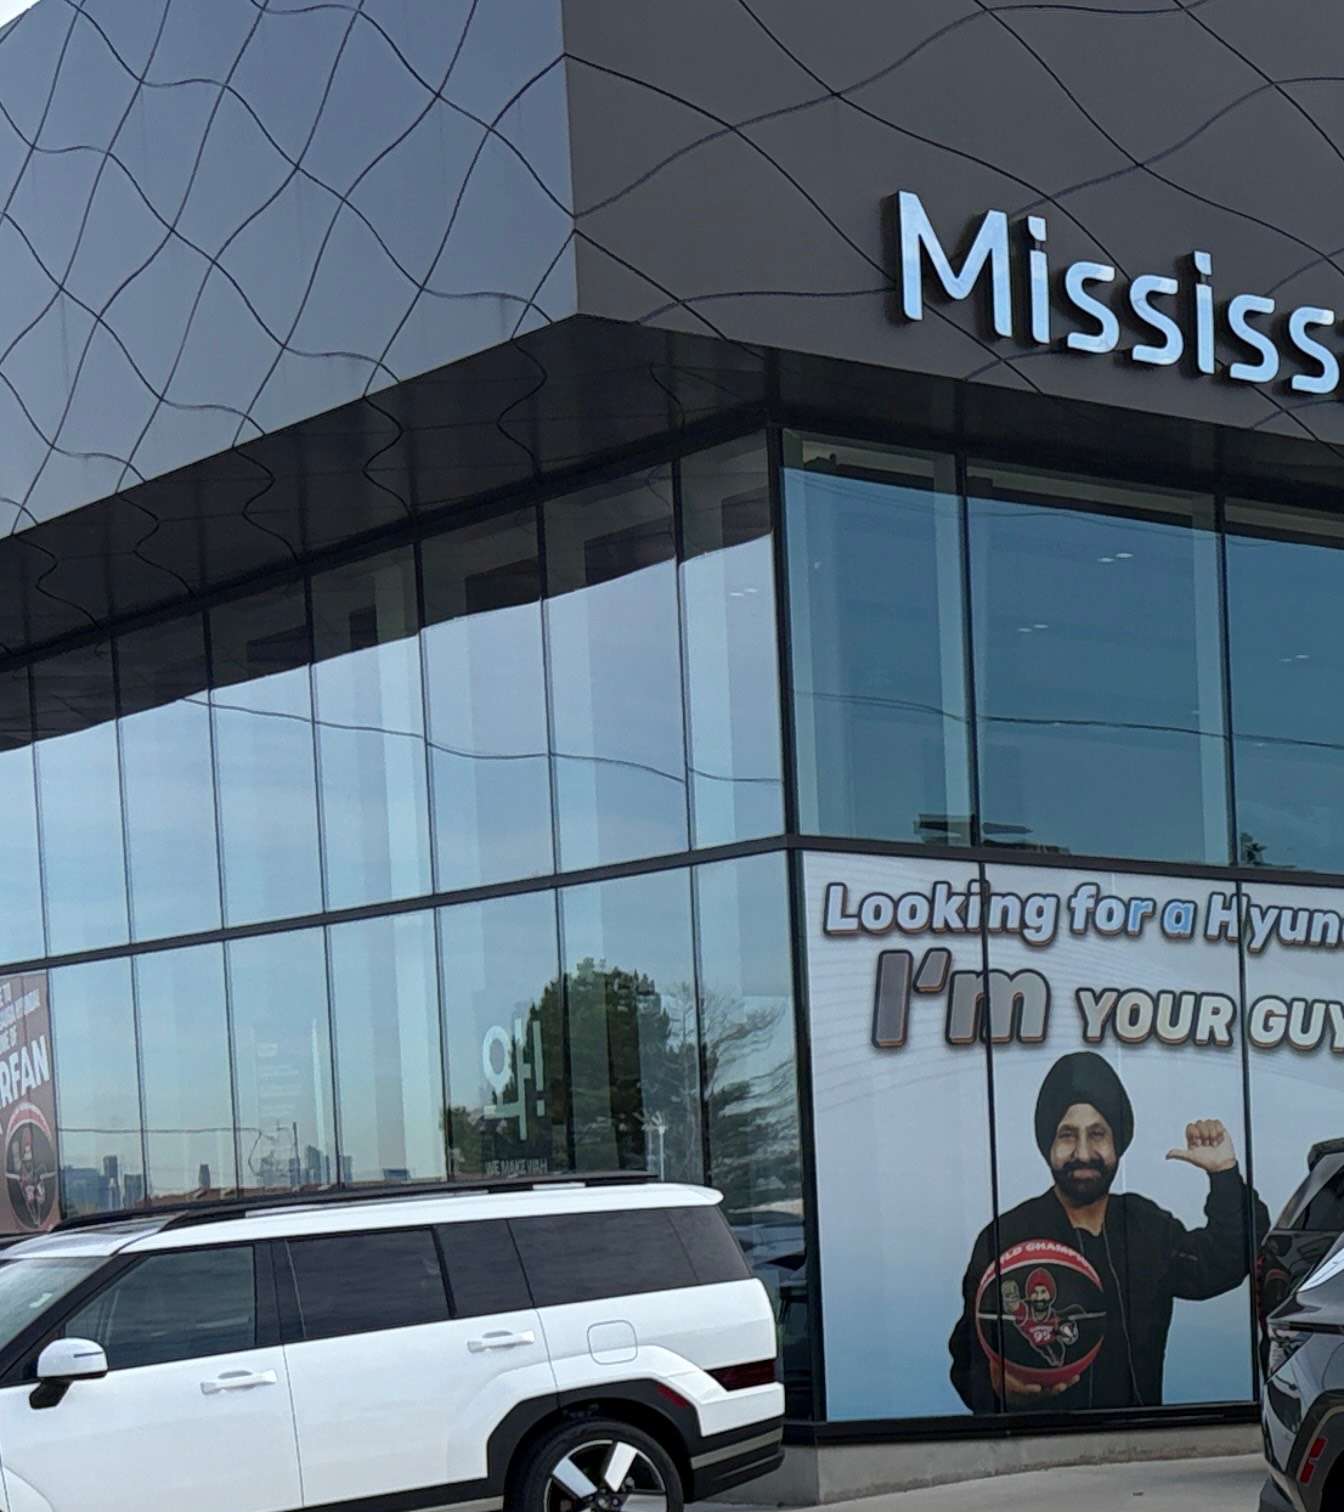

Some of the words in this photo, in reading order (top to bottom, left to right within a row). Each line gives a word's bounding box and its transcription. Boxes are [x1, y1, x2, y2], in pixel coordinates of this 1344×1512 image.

[824, 879, 1059, 944] Looking
[1068, 883, 1151, 939] for
[1163, 903, 1196, 941] a
[872, 947, 1052, 1049] I'm
[1075, 987, 1235, 1048] YOUR
